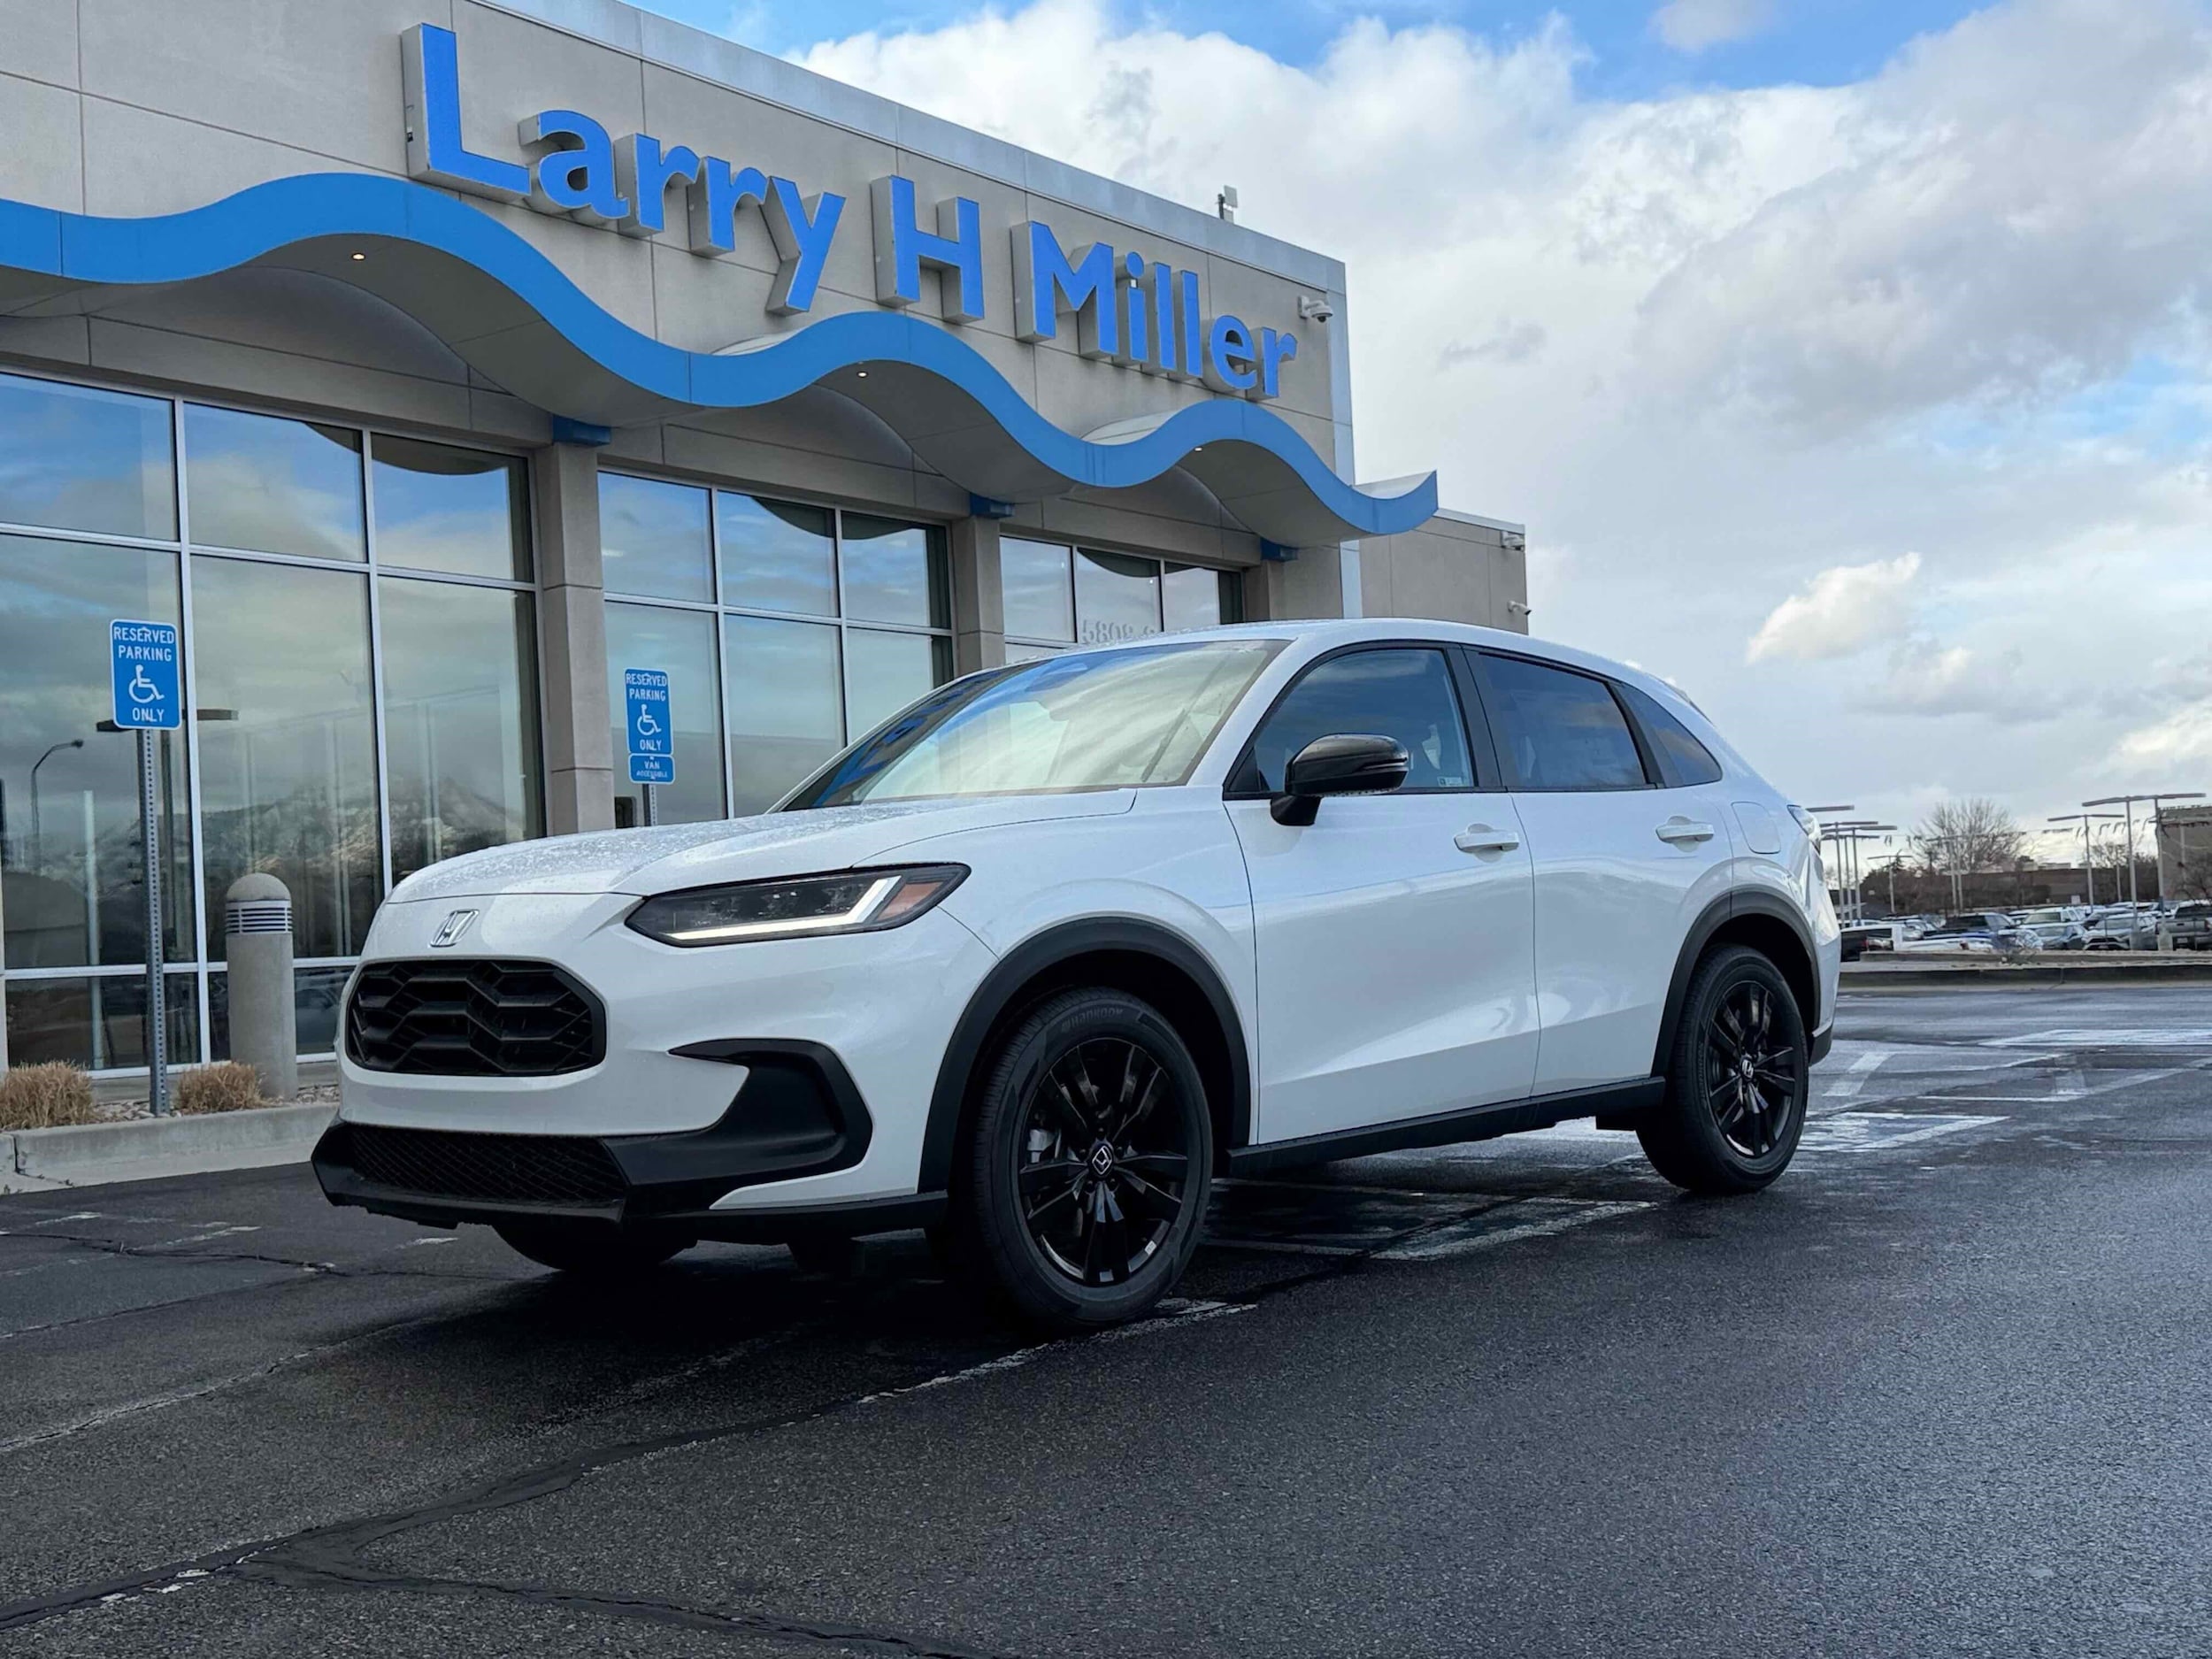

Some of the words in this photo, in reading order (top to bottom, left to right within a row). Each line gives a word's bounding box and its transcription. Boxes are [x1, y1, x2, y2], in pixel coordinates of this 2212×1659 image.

[419, 22, 848, 312] Larry
[887, 174, 985, 319] H
[1026, 220, 1298, 399] Miller
[113, 626, 175, 644] RESERVED
[118, 645, 173, 662] PARKING
[626, 673, 667, 687] RESERVED
[629, 688, 666, 702] PARKING
[132, 707, 165, 722] ONLY
[639, 740, 662, 751] ONLY
[644, 761, 660, 770] VAN
